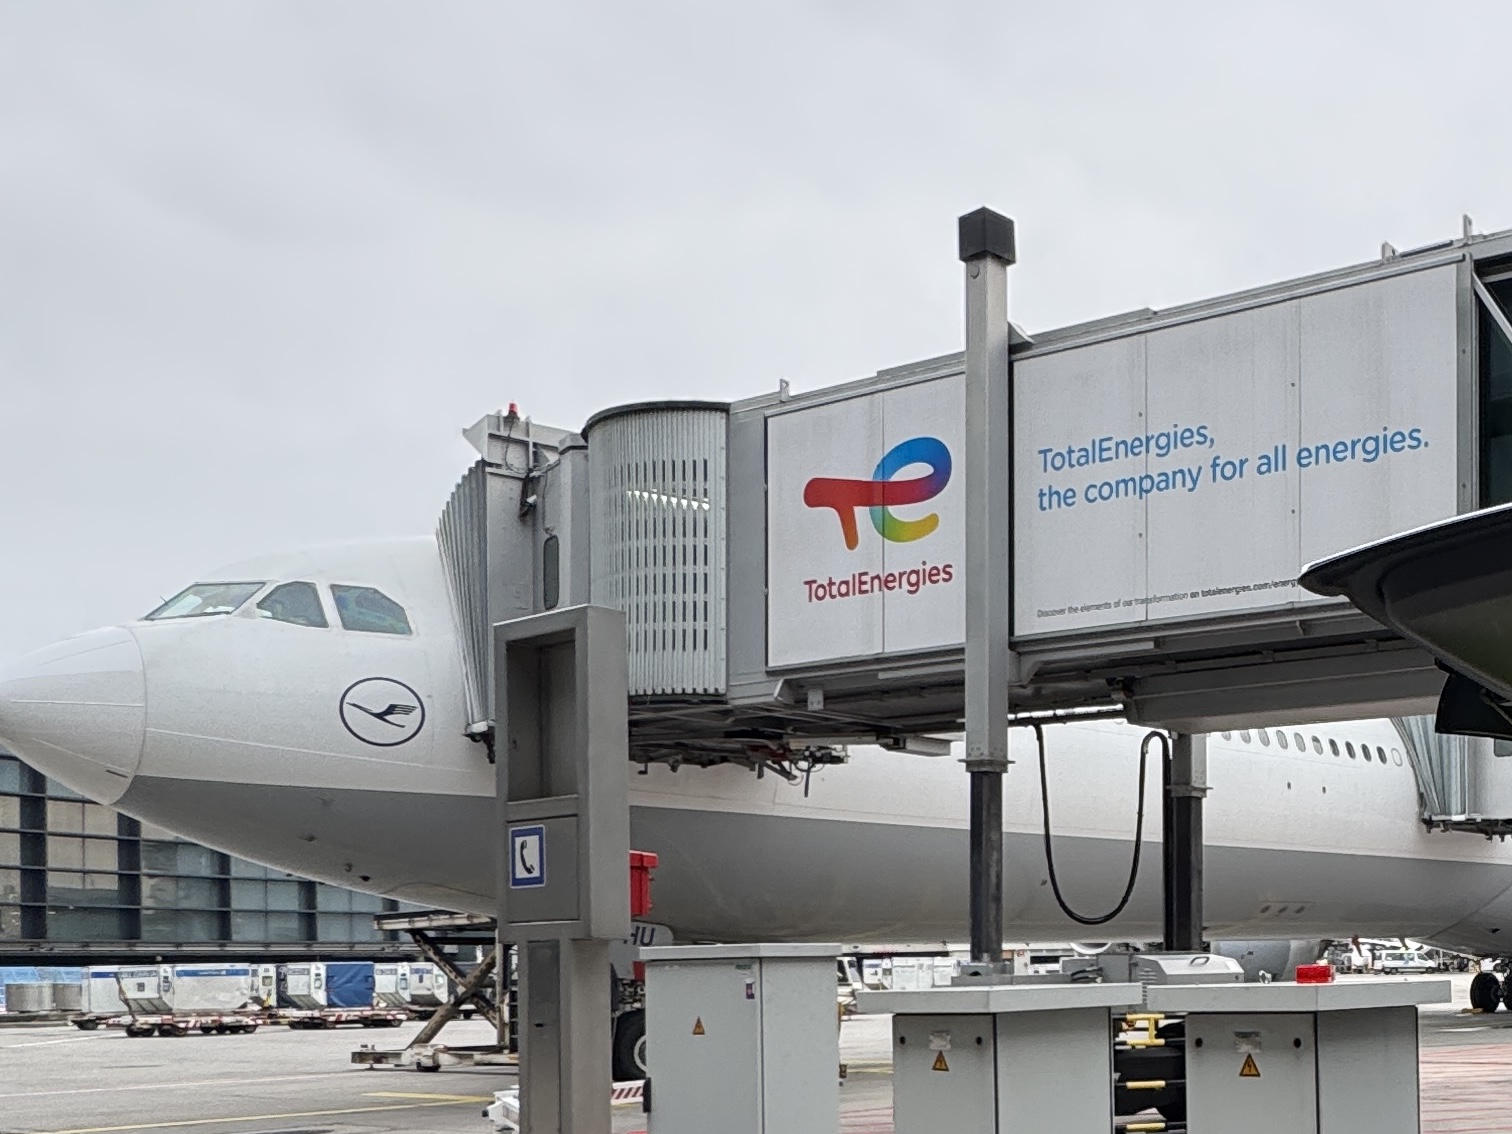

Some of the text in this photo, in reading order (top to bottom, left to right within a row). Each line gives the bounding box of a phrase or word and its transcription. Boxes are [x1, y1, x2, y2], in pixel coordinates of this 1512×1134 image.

[1037, 423, 1215, 473] TotalEnergies,
[1037, 426, 1429, 511] the company for all energies.
[803, 560, 953, 603] TotalEnergies
